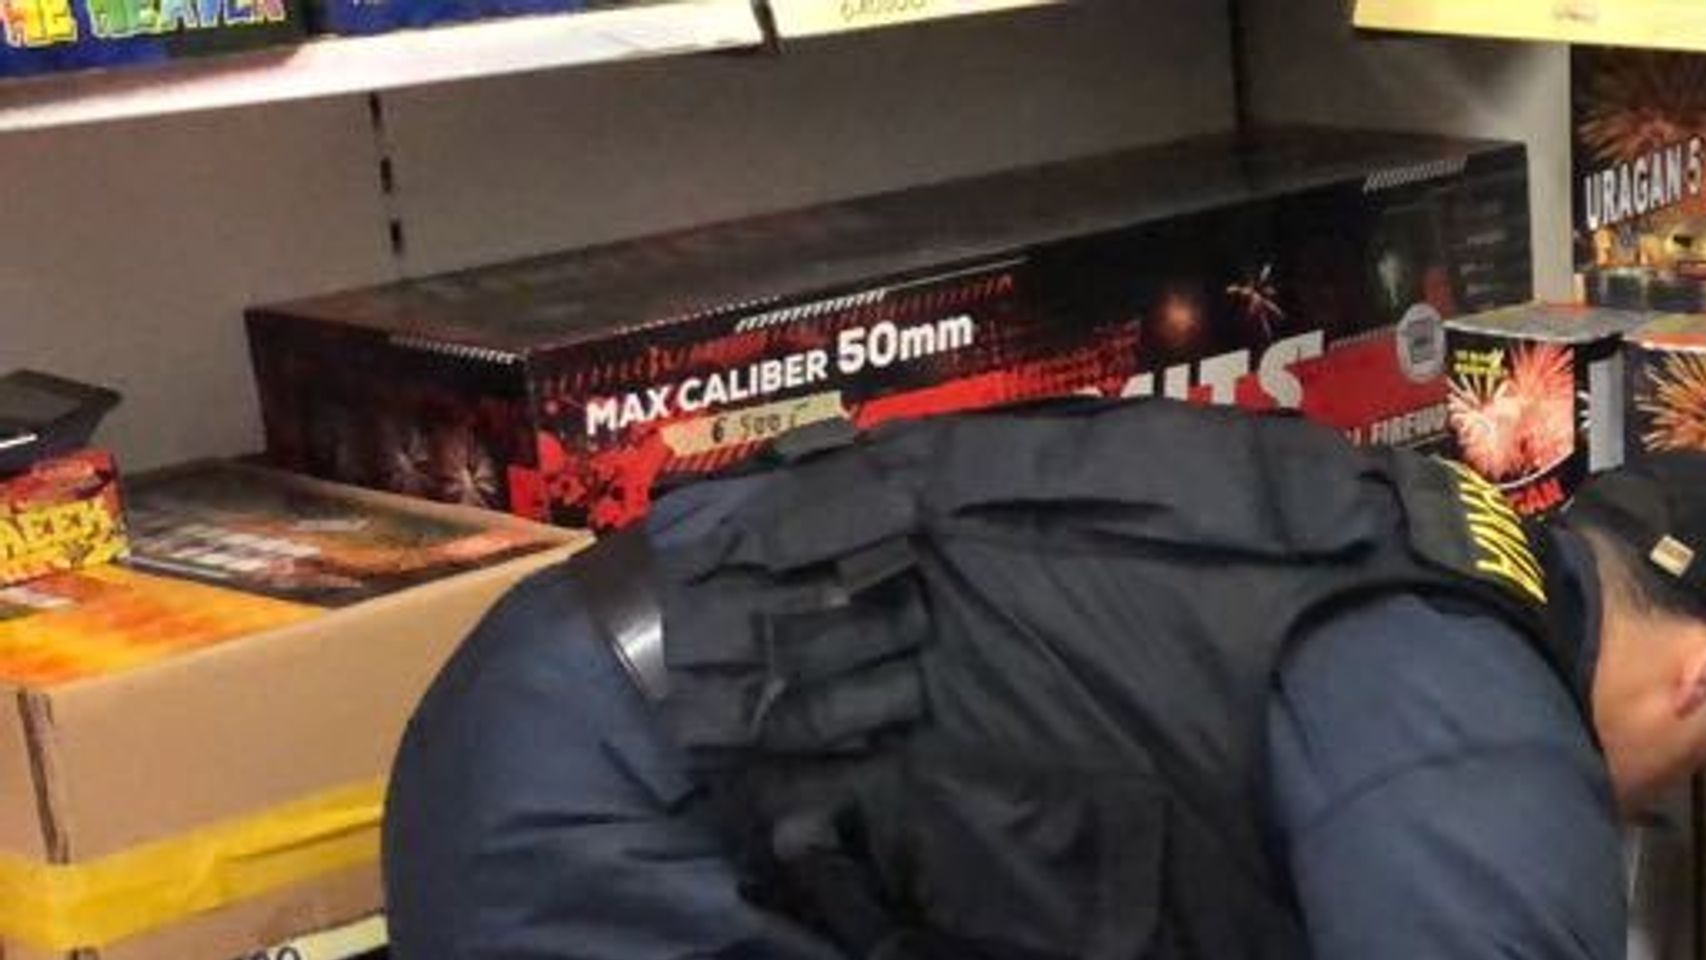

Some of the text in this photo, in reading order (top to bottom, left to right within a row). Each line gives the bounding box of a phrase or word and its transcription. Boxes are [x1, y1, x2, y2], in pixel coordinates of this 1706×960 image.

[1585, 137, 1701, 231] URAGAN 5
[587, 314, 973, 435] MAX CALIBER 50mm
